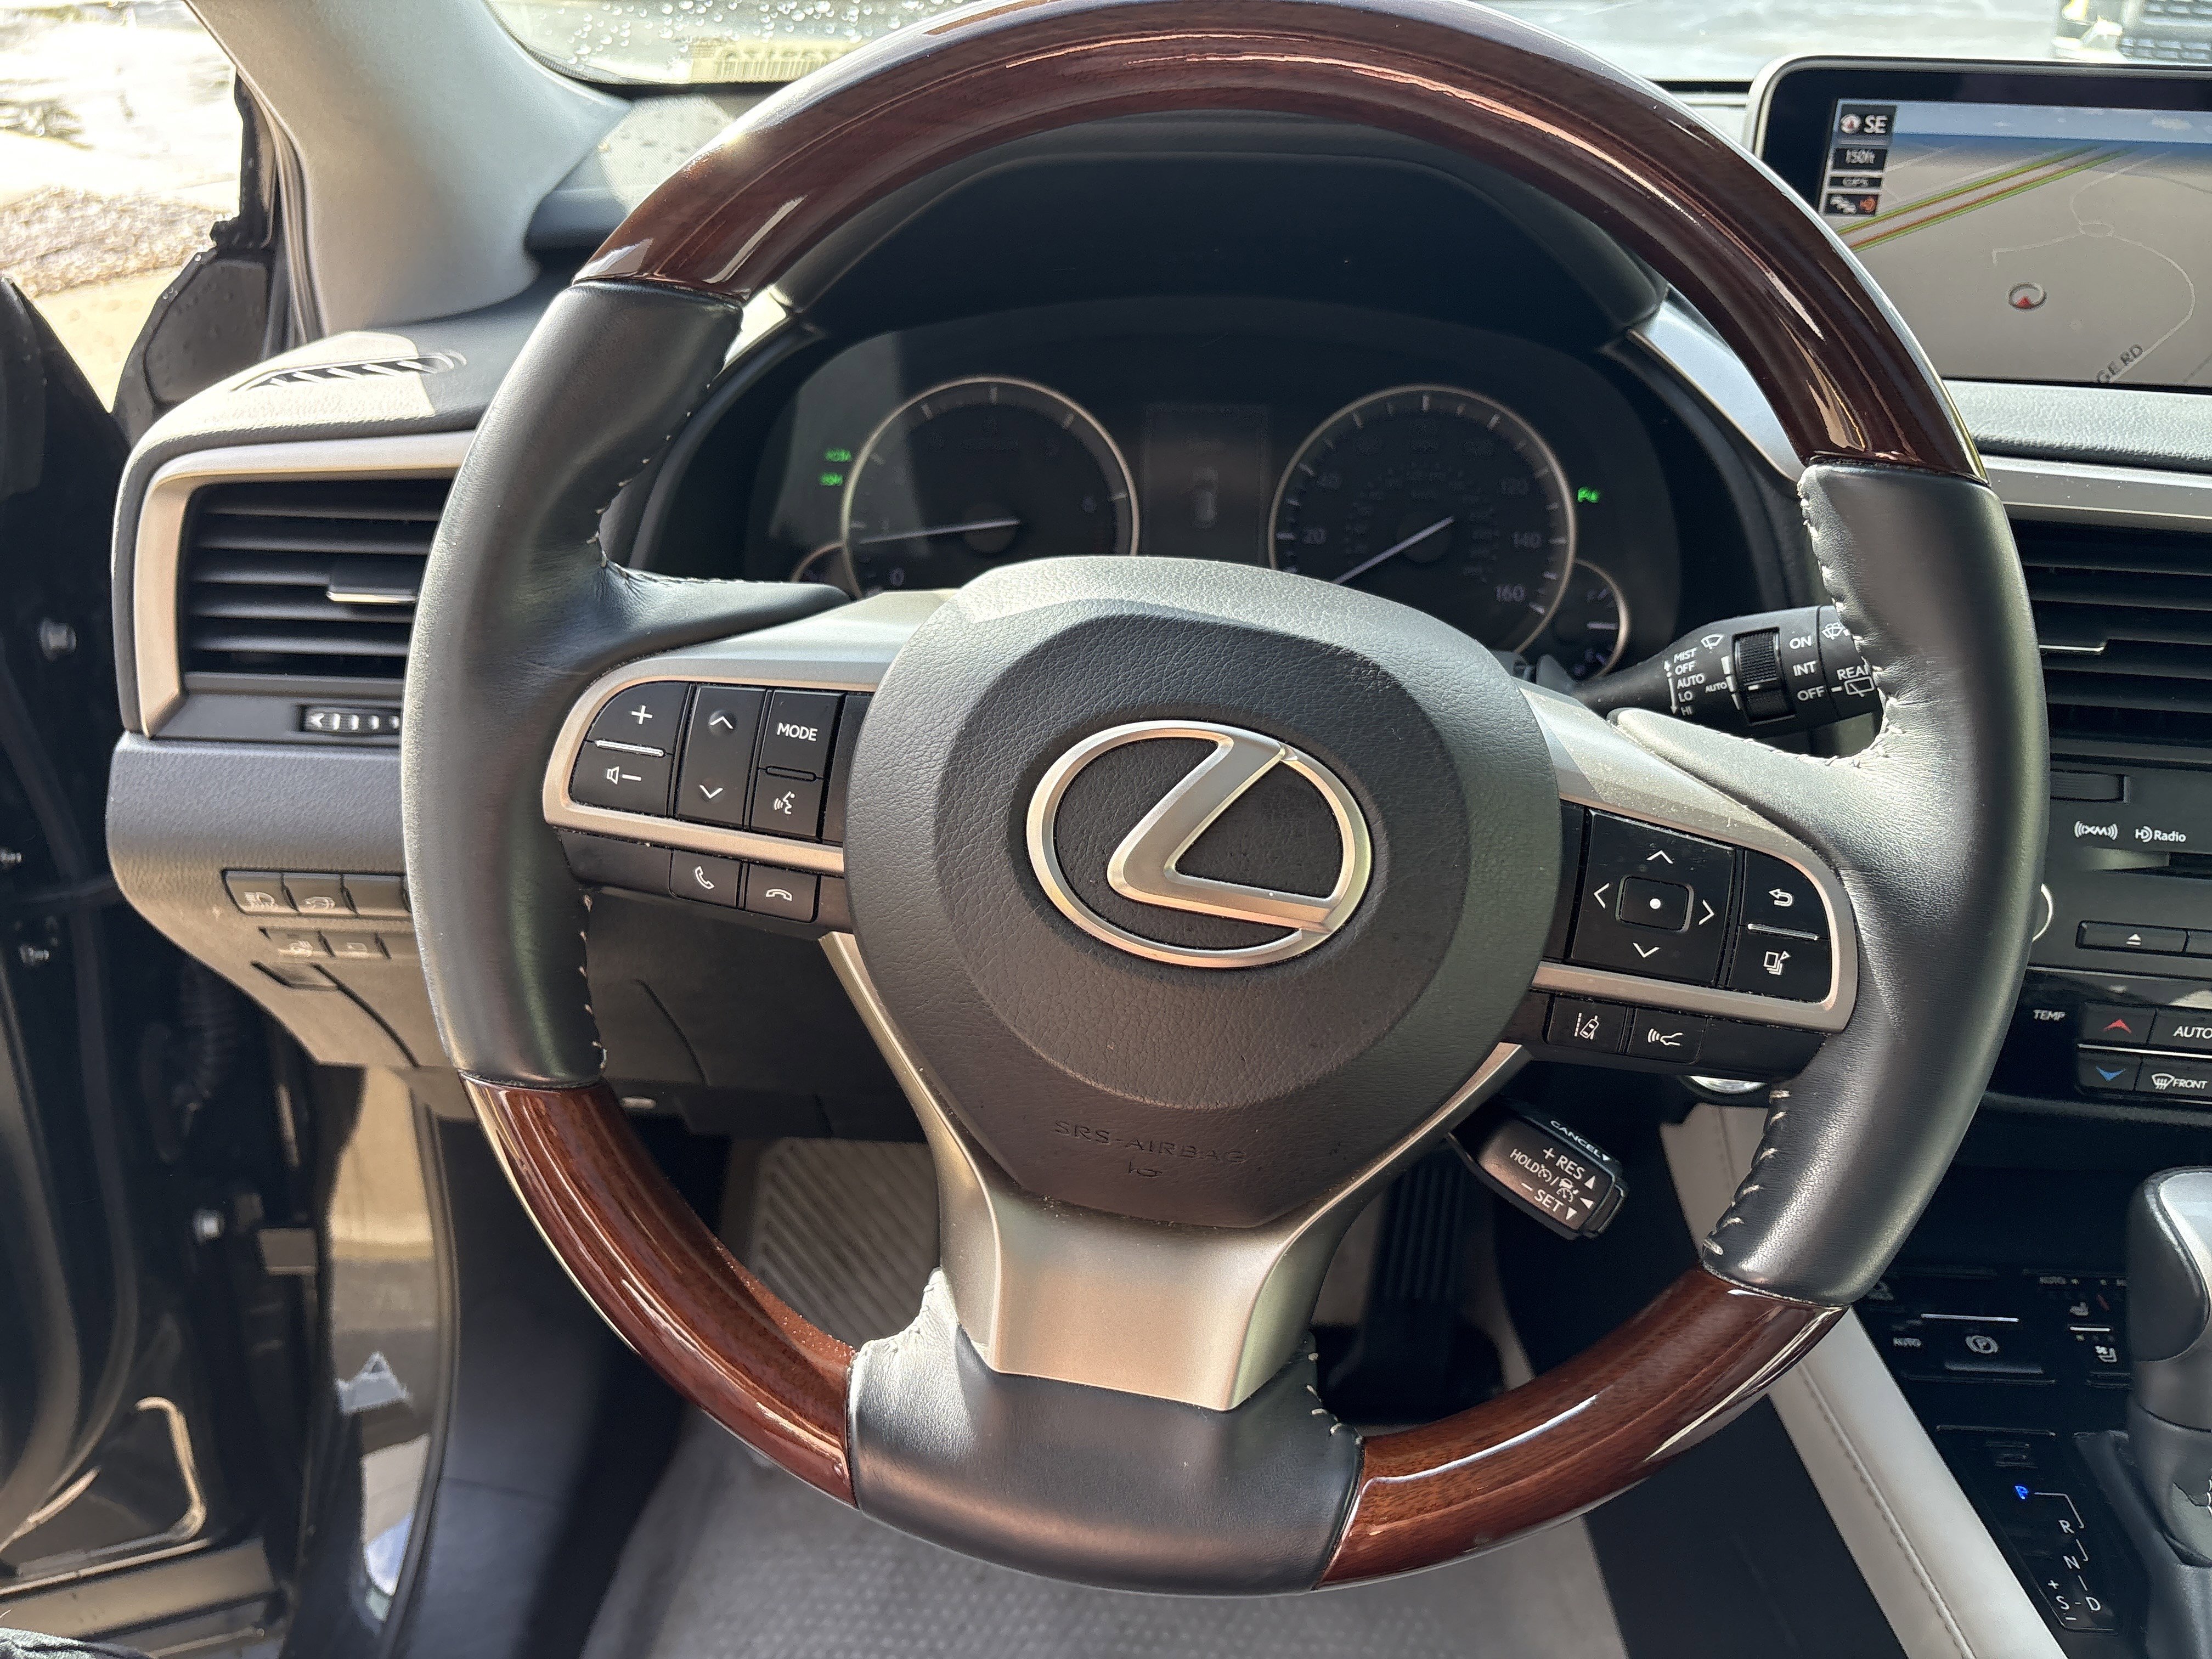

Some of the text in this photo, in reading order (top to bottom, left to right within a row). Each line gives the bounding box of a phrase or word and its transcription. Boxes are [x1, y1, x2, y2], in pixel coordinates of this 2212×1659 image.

[1864, 115, 1888, 133] SE
[2120, 343, 2144, 366] RD
[1496, 584, 1527, 602] 160
[1789, 635, 1812, 650] ON
[1673, 647, 1697, 664] MIST
[1675, 660, 1696, 675] OFF
[1792, 660, 1816, 677] INT
[1677, 673, 1705, 690] AUTO
[1705, 681, 1728, 693] AUTO
[1678, 690, 1694, 703] LO
[1797, 685, 1826, 702] OFF
[1680, 706, 1693, 716] HI
[776, 722, 818, 742] MODE
[2154, 830, 2187, 843] Radio
[2033, 1009, 2067, 1022] TEMP
[2173, 1025, 2212, 1040] AUTO
[2172, 1078, 2208, 1090] FRONT
[1550, 1120, 1604, 1159] CANCEL
[1509, 1148, 1540, 1173] HOLD
[1555, 1155, 1585, 1180] RES
[1534, 1188, 1564, 1213] SET
[2058, 1519, 2075, 1534] R
[2063, 1555, 2081, 1570] N
[2056, 1595, 2102, 1611] S D
